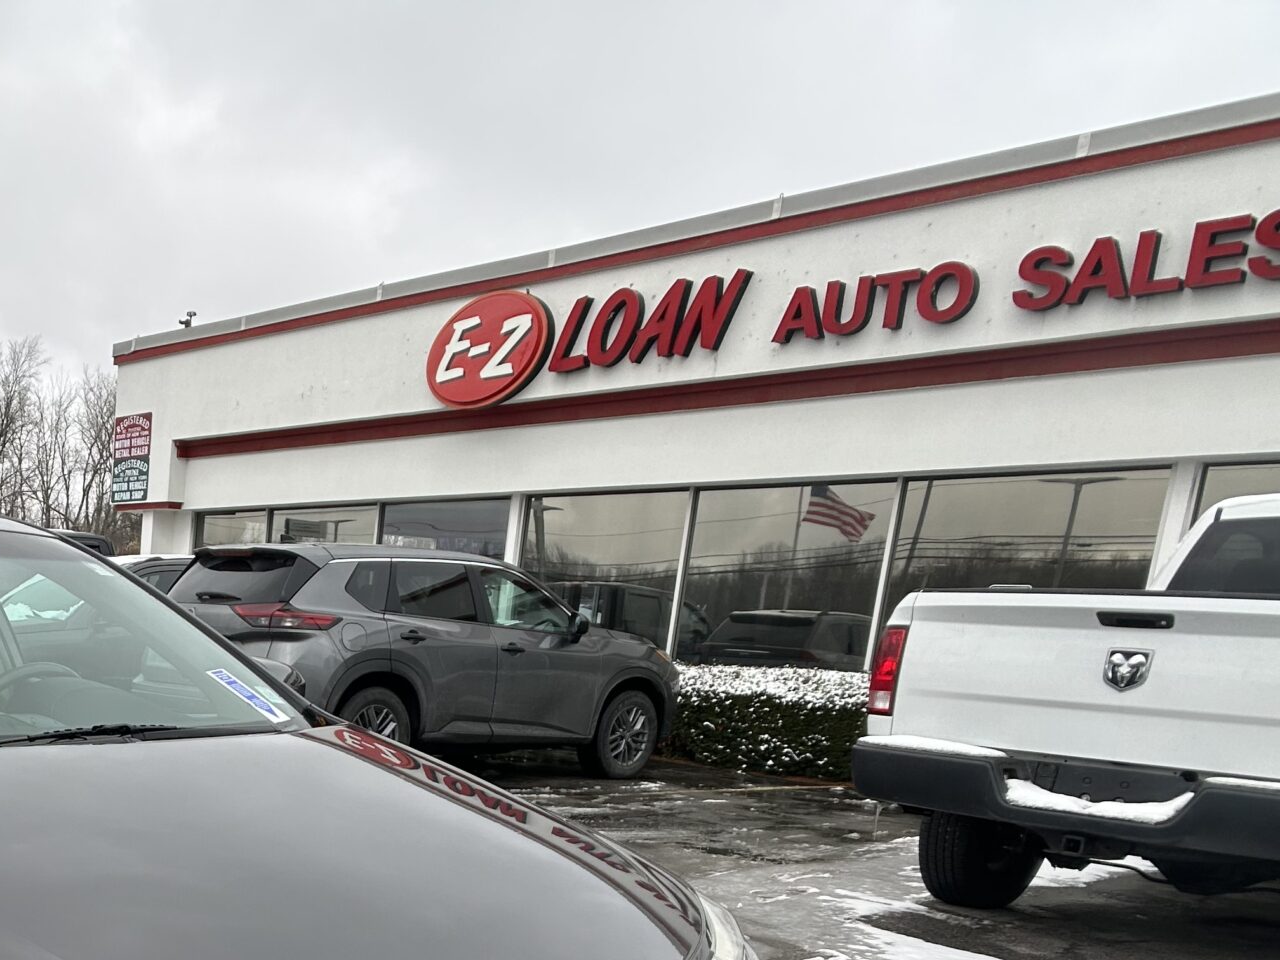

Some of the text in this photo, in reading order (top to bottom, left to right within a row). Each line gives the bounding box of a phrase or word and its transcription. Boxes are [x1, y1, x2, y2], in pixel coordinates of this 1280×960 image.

[434, 209, 1280, 384] E-Z LOAN AUTO SALES
[117, 416, 149, 433] REGISTERED
[114, 459, 148, 475] REGISTERED
